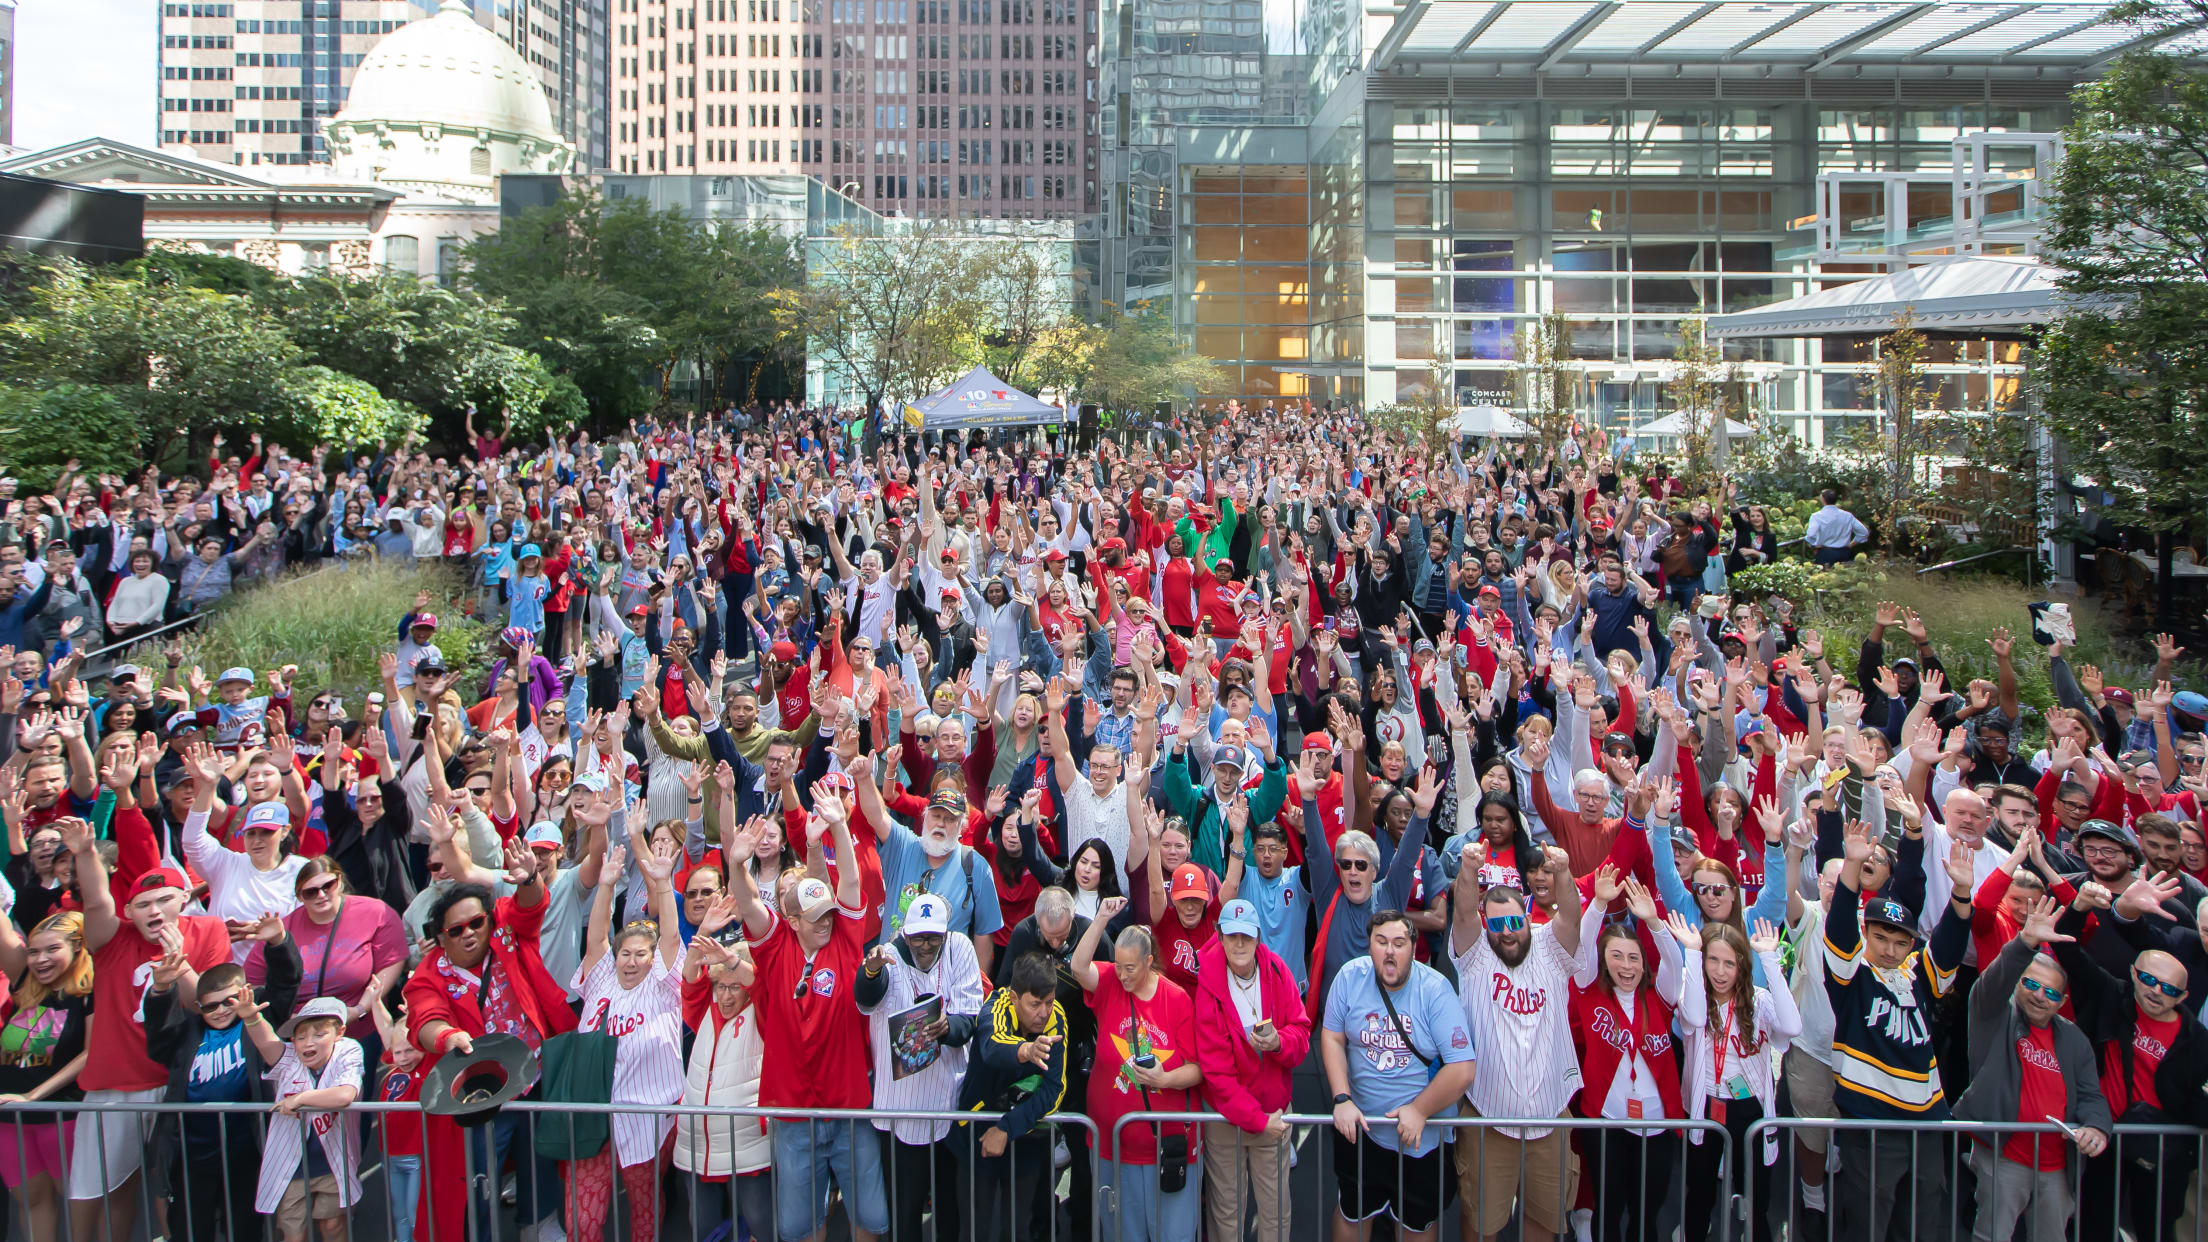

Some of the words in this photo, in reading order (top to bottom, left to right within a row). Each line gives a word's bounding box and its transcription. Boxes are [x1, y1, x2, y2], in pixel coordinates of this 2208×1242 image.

[967, 390, 987, 401] 10
[1185, 873, 1195, 887] P
[1284, 887, 1294, 907] P
[1235, 907, 1244, 919] P
[1493, 972, 1547, 1015] Phillies
[587, 997, 644, 1037] Pllies
[734, 1015, 745, 1039] P
[1361, 1030, 1408, 1050] OCTOBE
